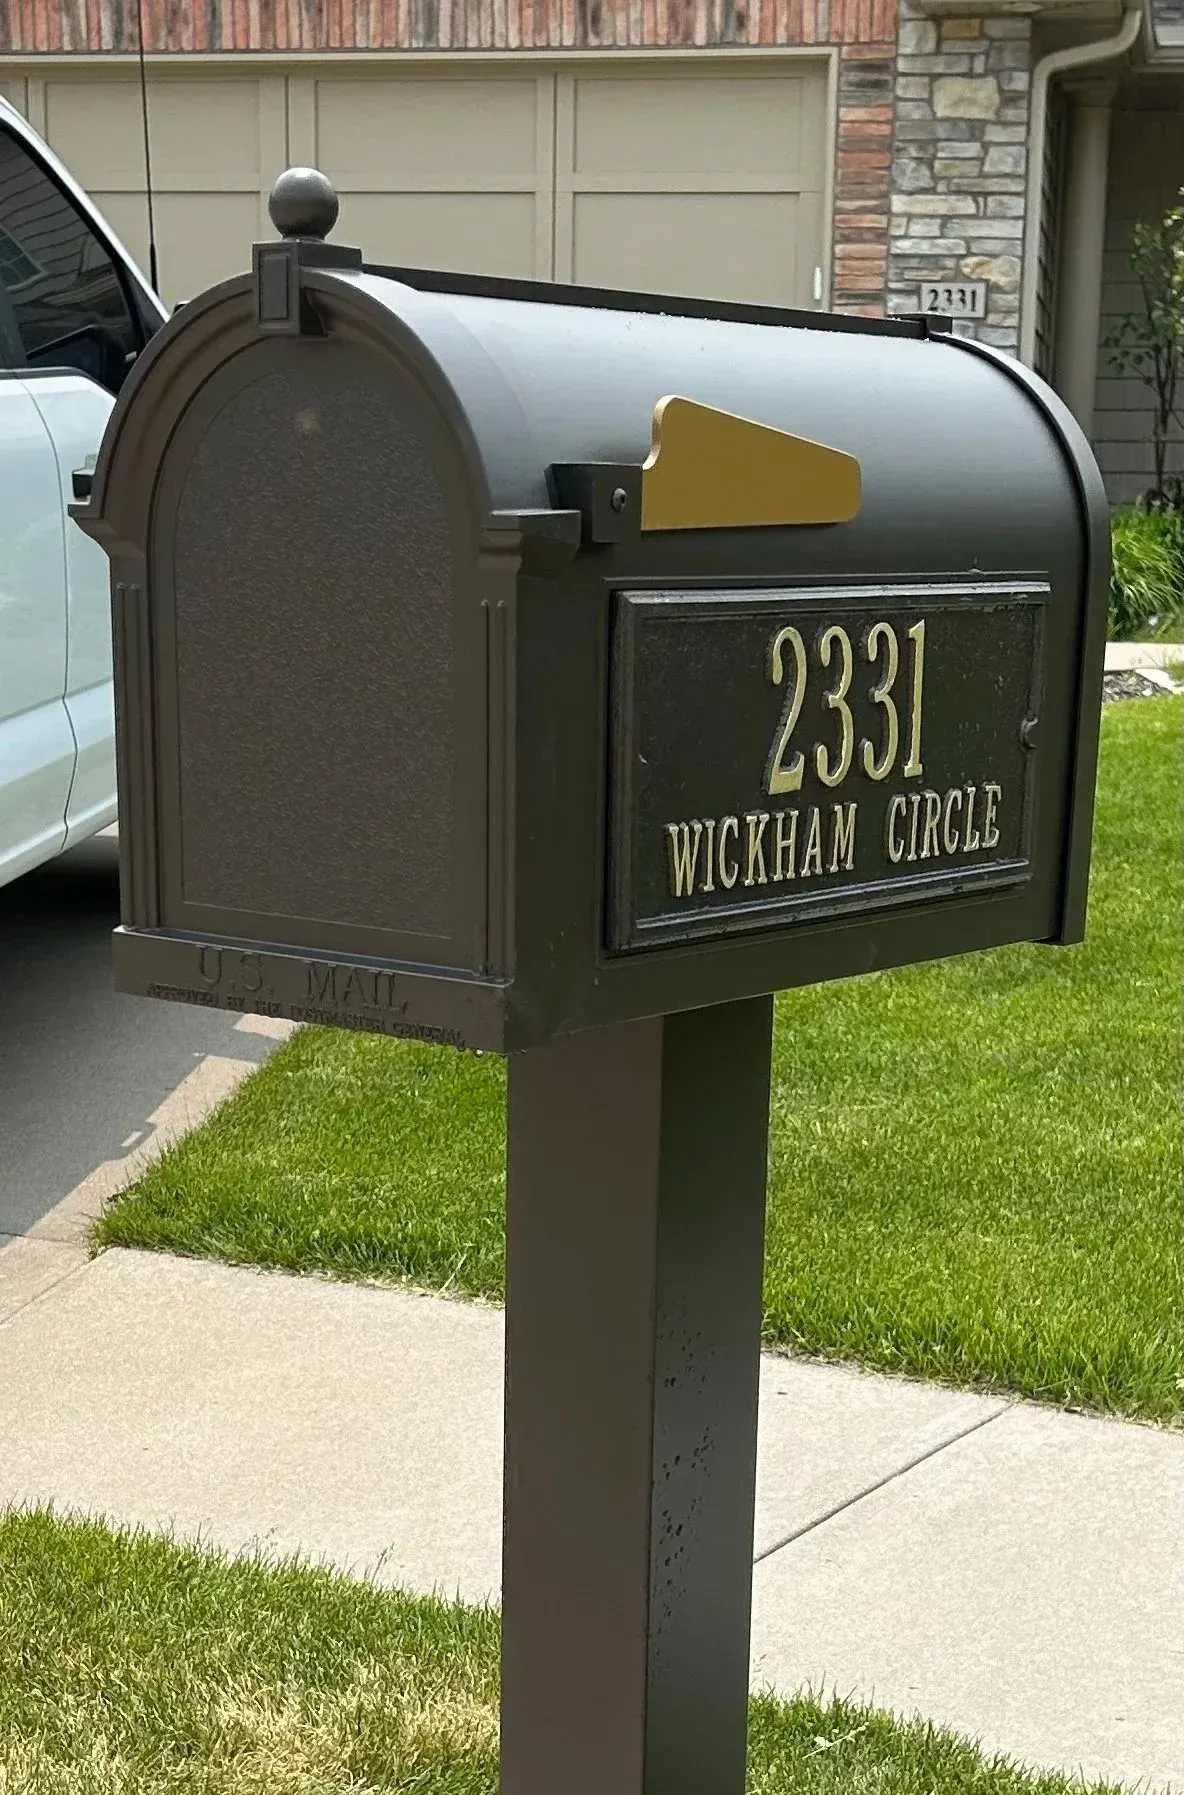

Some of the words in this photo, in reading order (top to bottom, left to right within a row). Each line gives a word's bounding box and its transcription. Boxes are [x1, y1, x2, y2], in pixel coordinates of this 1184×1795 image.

[927, 288, 977, 312] 2331
[766, 619, 926, 796] 2331
[666, 802, 858, 897] WICKHAM
[886, 782, 1002, 864] CIRCLE
[195, 944, 275, 996] U.S.
[303, 960, 409, 1014] MAIL
